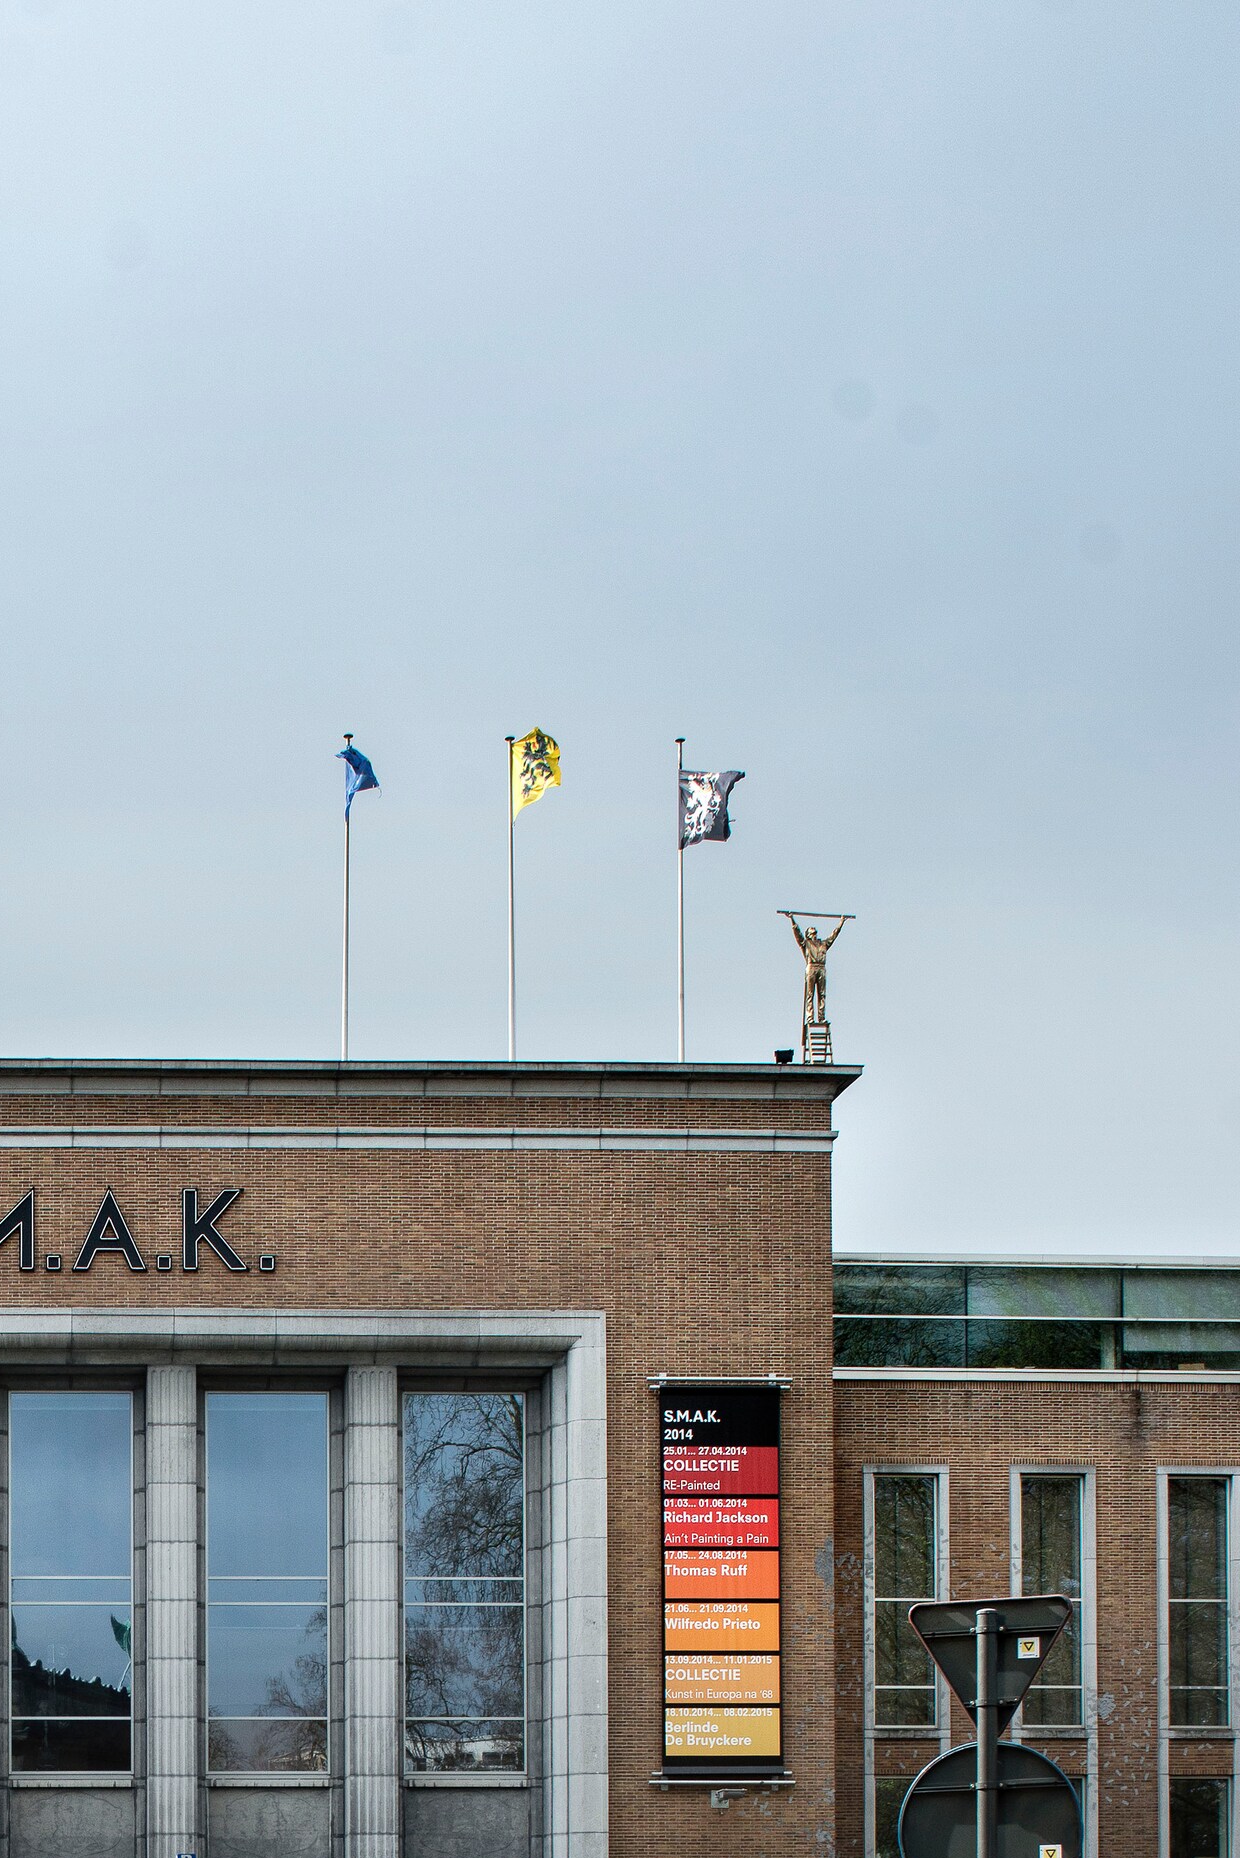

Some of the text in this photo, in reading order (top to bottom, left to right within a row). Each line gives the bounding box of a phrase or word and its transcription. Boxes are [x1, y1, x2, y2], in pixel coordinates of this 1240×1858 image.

[664, 1410, 721, 1423] S.M.A.K.
[664, 1428, 694, 1440] 2014
[663, 1446, 748, 1455] 25.01... 27.04.2014
[663, 1459, 739, 1472] COLLECTIE
[663, 1480, 721, 1490] RE-Painted
[663, 1498, 748, 1508] 01.03... 01.06.2014
[663, 1511, 769, 1523] Richard Jackson
[691, 1533, 734, 1545] Painting
[736, 1536, 743, 1544] a
[746, 1533, 769, 1544] Pain
[663, 1550, 748, 1560] 17.05... 24.08.2014
[664, 1564, 748, 1576] Thomas Ruff
[664, 1604, 749, 1613] 21.06... 21.09.2014
[665, 1618, 761, 1630] Wilfredo Prieto
[723, 1655, 773, 1664] 11.01.2015
[665, 1669, 741, 1681] COLLECTIE
[665, 1689, 693, 1699] Kunst
[695, 1689, 704, 1699] in
[706, 1689, 742, 1700] Europa
[744, 1690, 757, 1699] na
[723, 1708, 773, 1717] 08.02.2015
[665, 1721, 719, 1733] Berlinde
[665, 1734, 752, 1748] De Bruyckere
